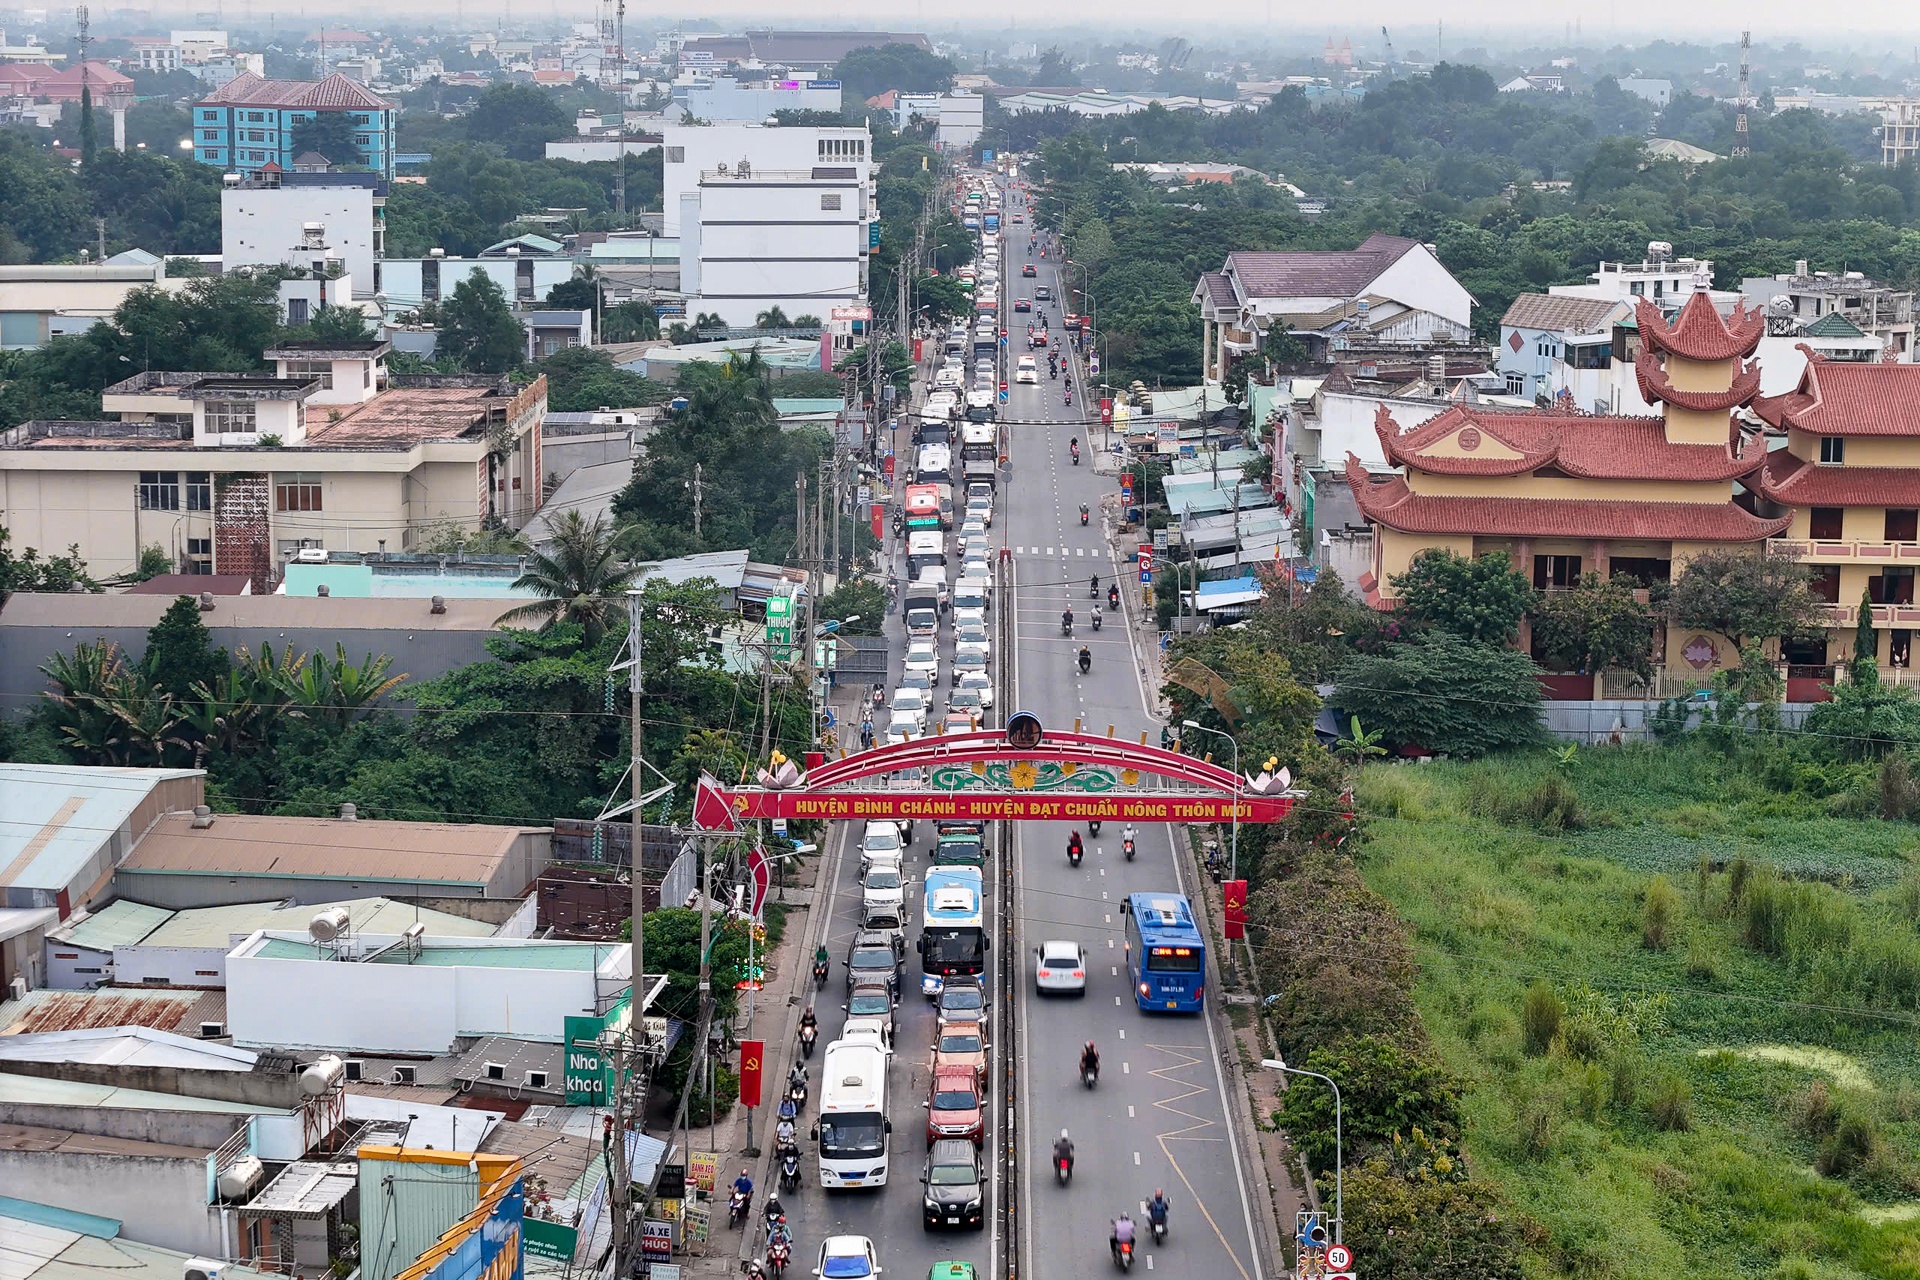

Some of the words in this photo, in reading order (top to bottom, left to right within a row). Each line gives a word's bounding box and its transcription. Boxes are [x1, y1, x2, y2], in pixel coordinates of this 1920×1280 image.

[767, 613, 790, 628] THUỐC
[796, 798, 848, 816] HUYỆN
[854, 798, 893, 814] BÌNH
[900, 797, 955, 814] CHÁNH
[970, 798, 1025, 818] HUYỆN
[1029, 803, 1061, 819] ĐẠT
[1065, 799, 1118, 816] CHUẨN
[1124, 801, 1167, 817] NÔNG
[1172, 801, 1215, 817] THÔN
[1221, 801, 1252, 817] MỚI
[570, 1054, 598, 1071] Nha
[566, 1075, 603, 1092] khoa
[642, 1223, 655, 1235] ỬA
[658, 1227, 670, 1237] XE
[1332, 1252, 1345, 1263] 50
